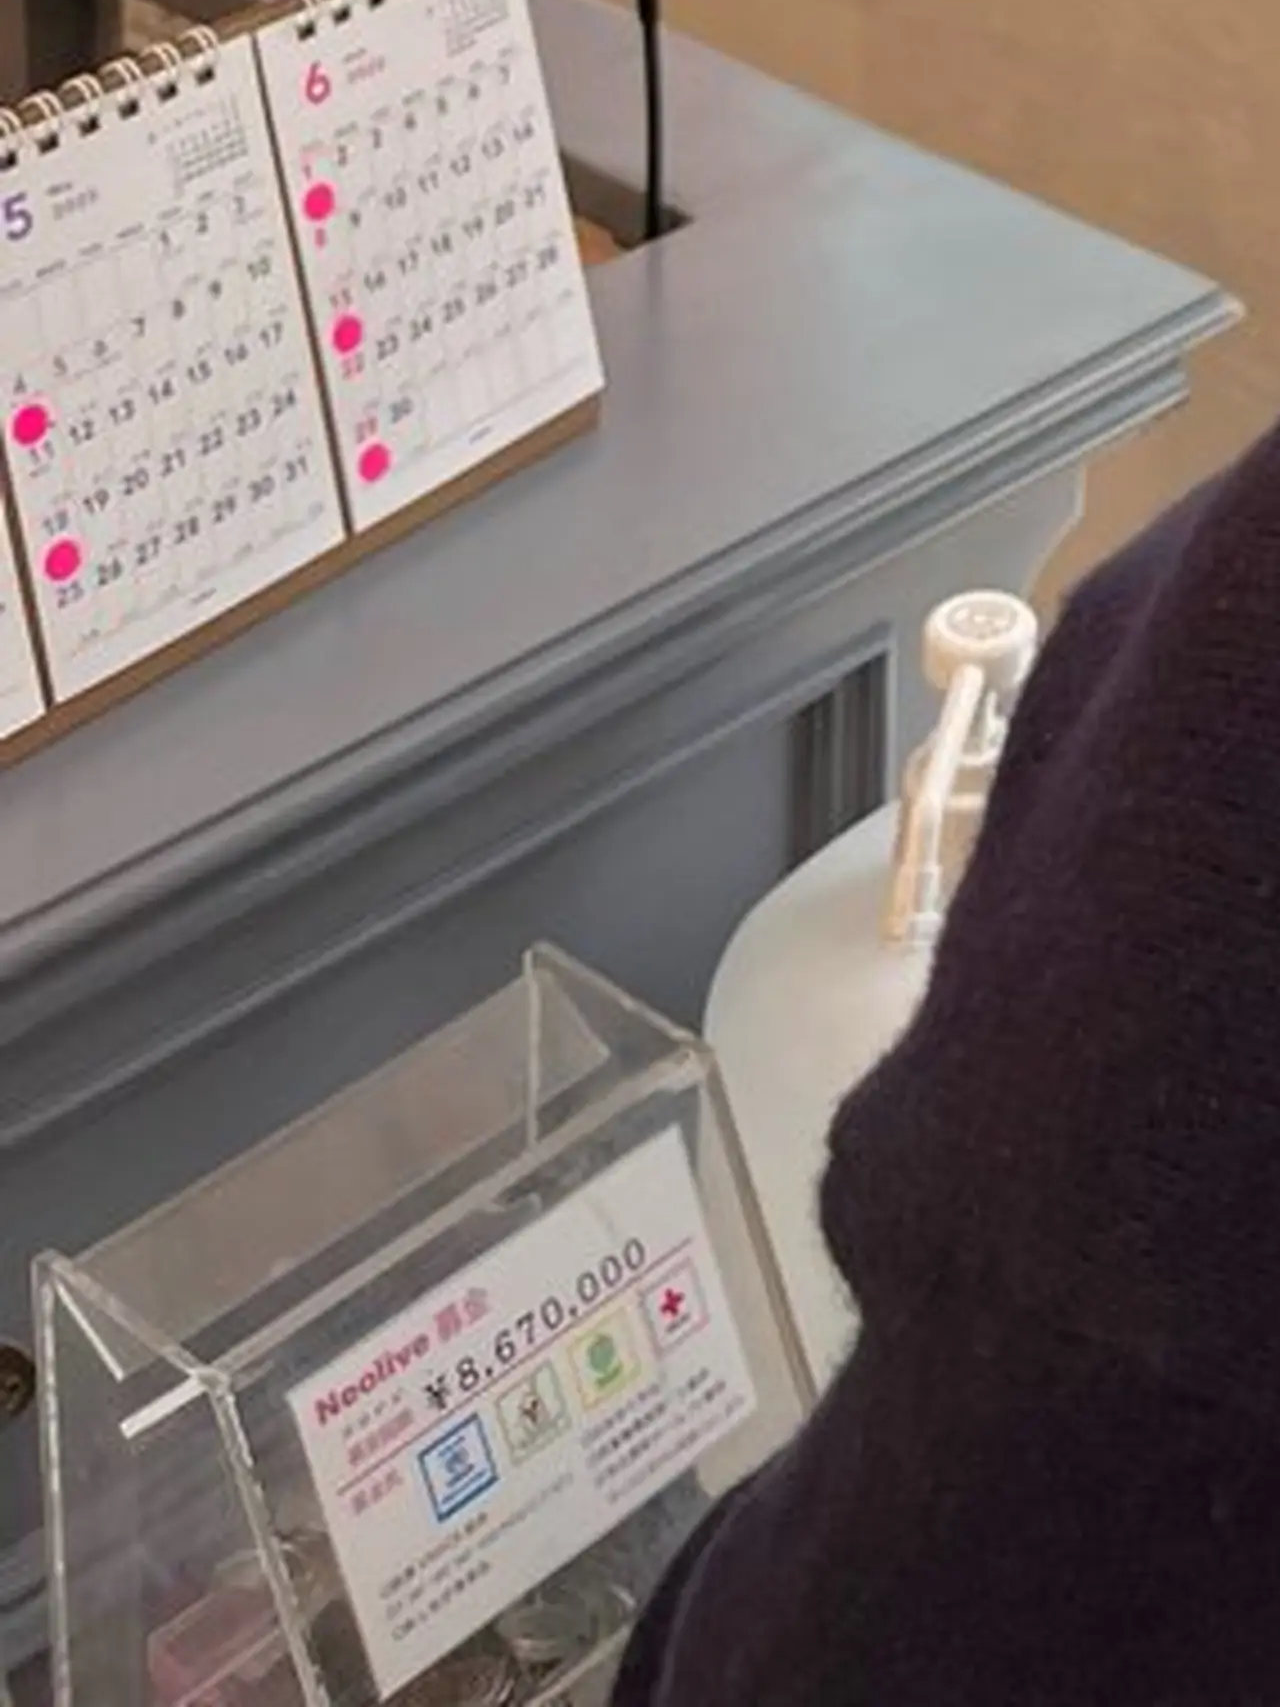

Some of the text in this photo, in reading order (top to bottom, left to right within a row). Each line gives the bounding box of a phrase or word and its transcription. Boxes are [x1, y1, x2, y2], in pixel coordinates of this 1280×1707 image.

[304, 61, 332, 105] 6
[1, 191, 33, 242] 5
[131, 316, 146, 338] 7
[246, 254, 272, 281] 10
[68, 418, 96, 446] 12
[108, 398, 137, 425] 13
[148, 378, 175, 405] 14
[185, 359, 213, 385] 15
[223, 342, 250, 367] 16
[258, 319, 284, 349] 17
[376, 335, 399, 361] 23
[81, 487, 110, 515] 19
[122, 466, 150, 497] 20
[160, 447, 187, 479] 21
[199, 425, 224, 456] 22
[235, 407, 262, 438] 23
[270, 387, 297, 418] 24
[96, 557, 123, 587] 26
[135, 536, 162, 566] 27
[174, 515, 201, 545] 28
[212, 494, 238, 525] 29
[250, 474, 276, 504] 30
[284, 454, 310, 483] 31
